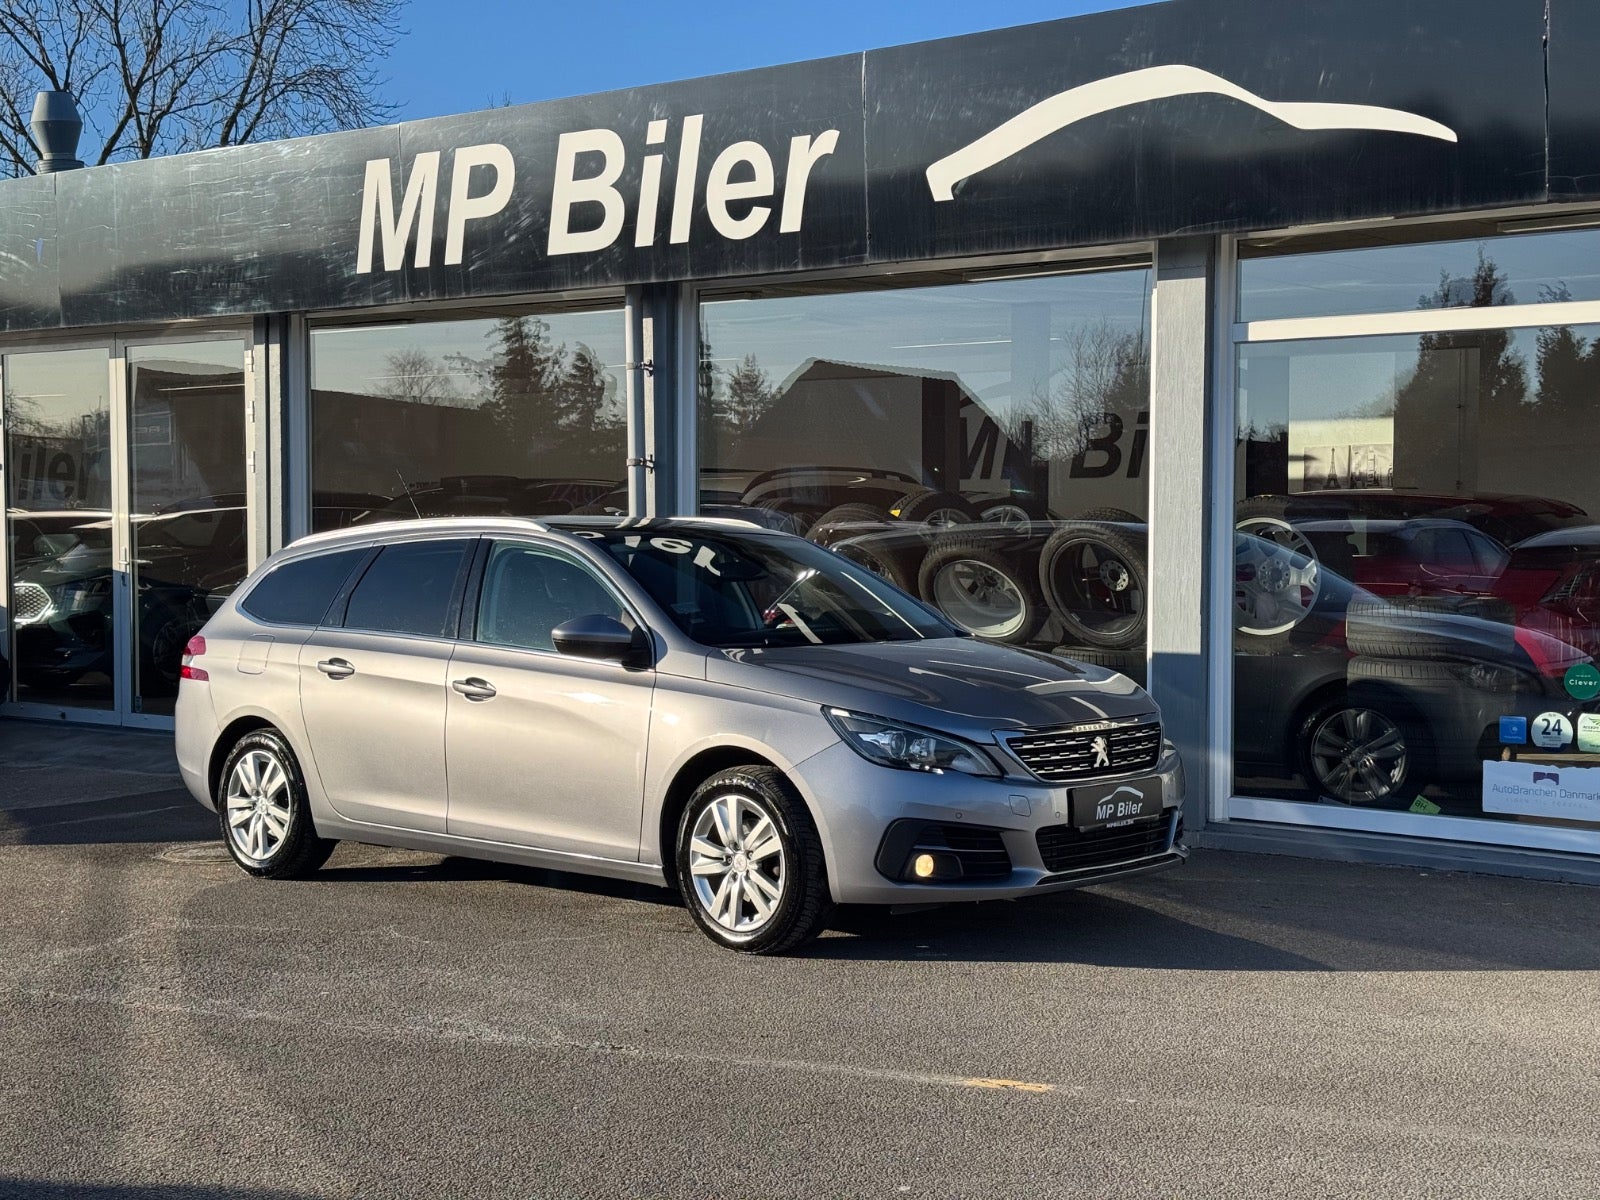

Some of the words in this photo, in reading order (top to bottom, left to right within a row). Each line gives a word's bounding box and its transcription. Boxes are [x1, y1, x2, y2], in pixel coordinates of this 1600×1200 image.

[356, 143, 516, 275] MP
[547, 113, 840, 257] Biler
[14, 440, 102, 500] iler
[1541, 718, 1563, 736] 24
[1492, 784, 1556, 797] AutoBranchen
[1096, 804, 1115, 820] MP
[1117, 800, 1143, 817] Biler
